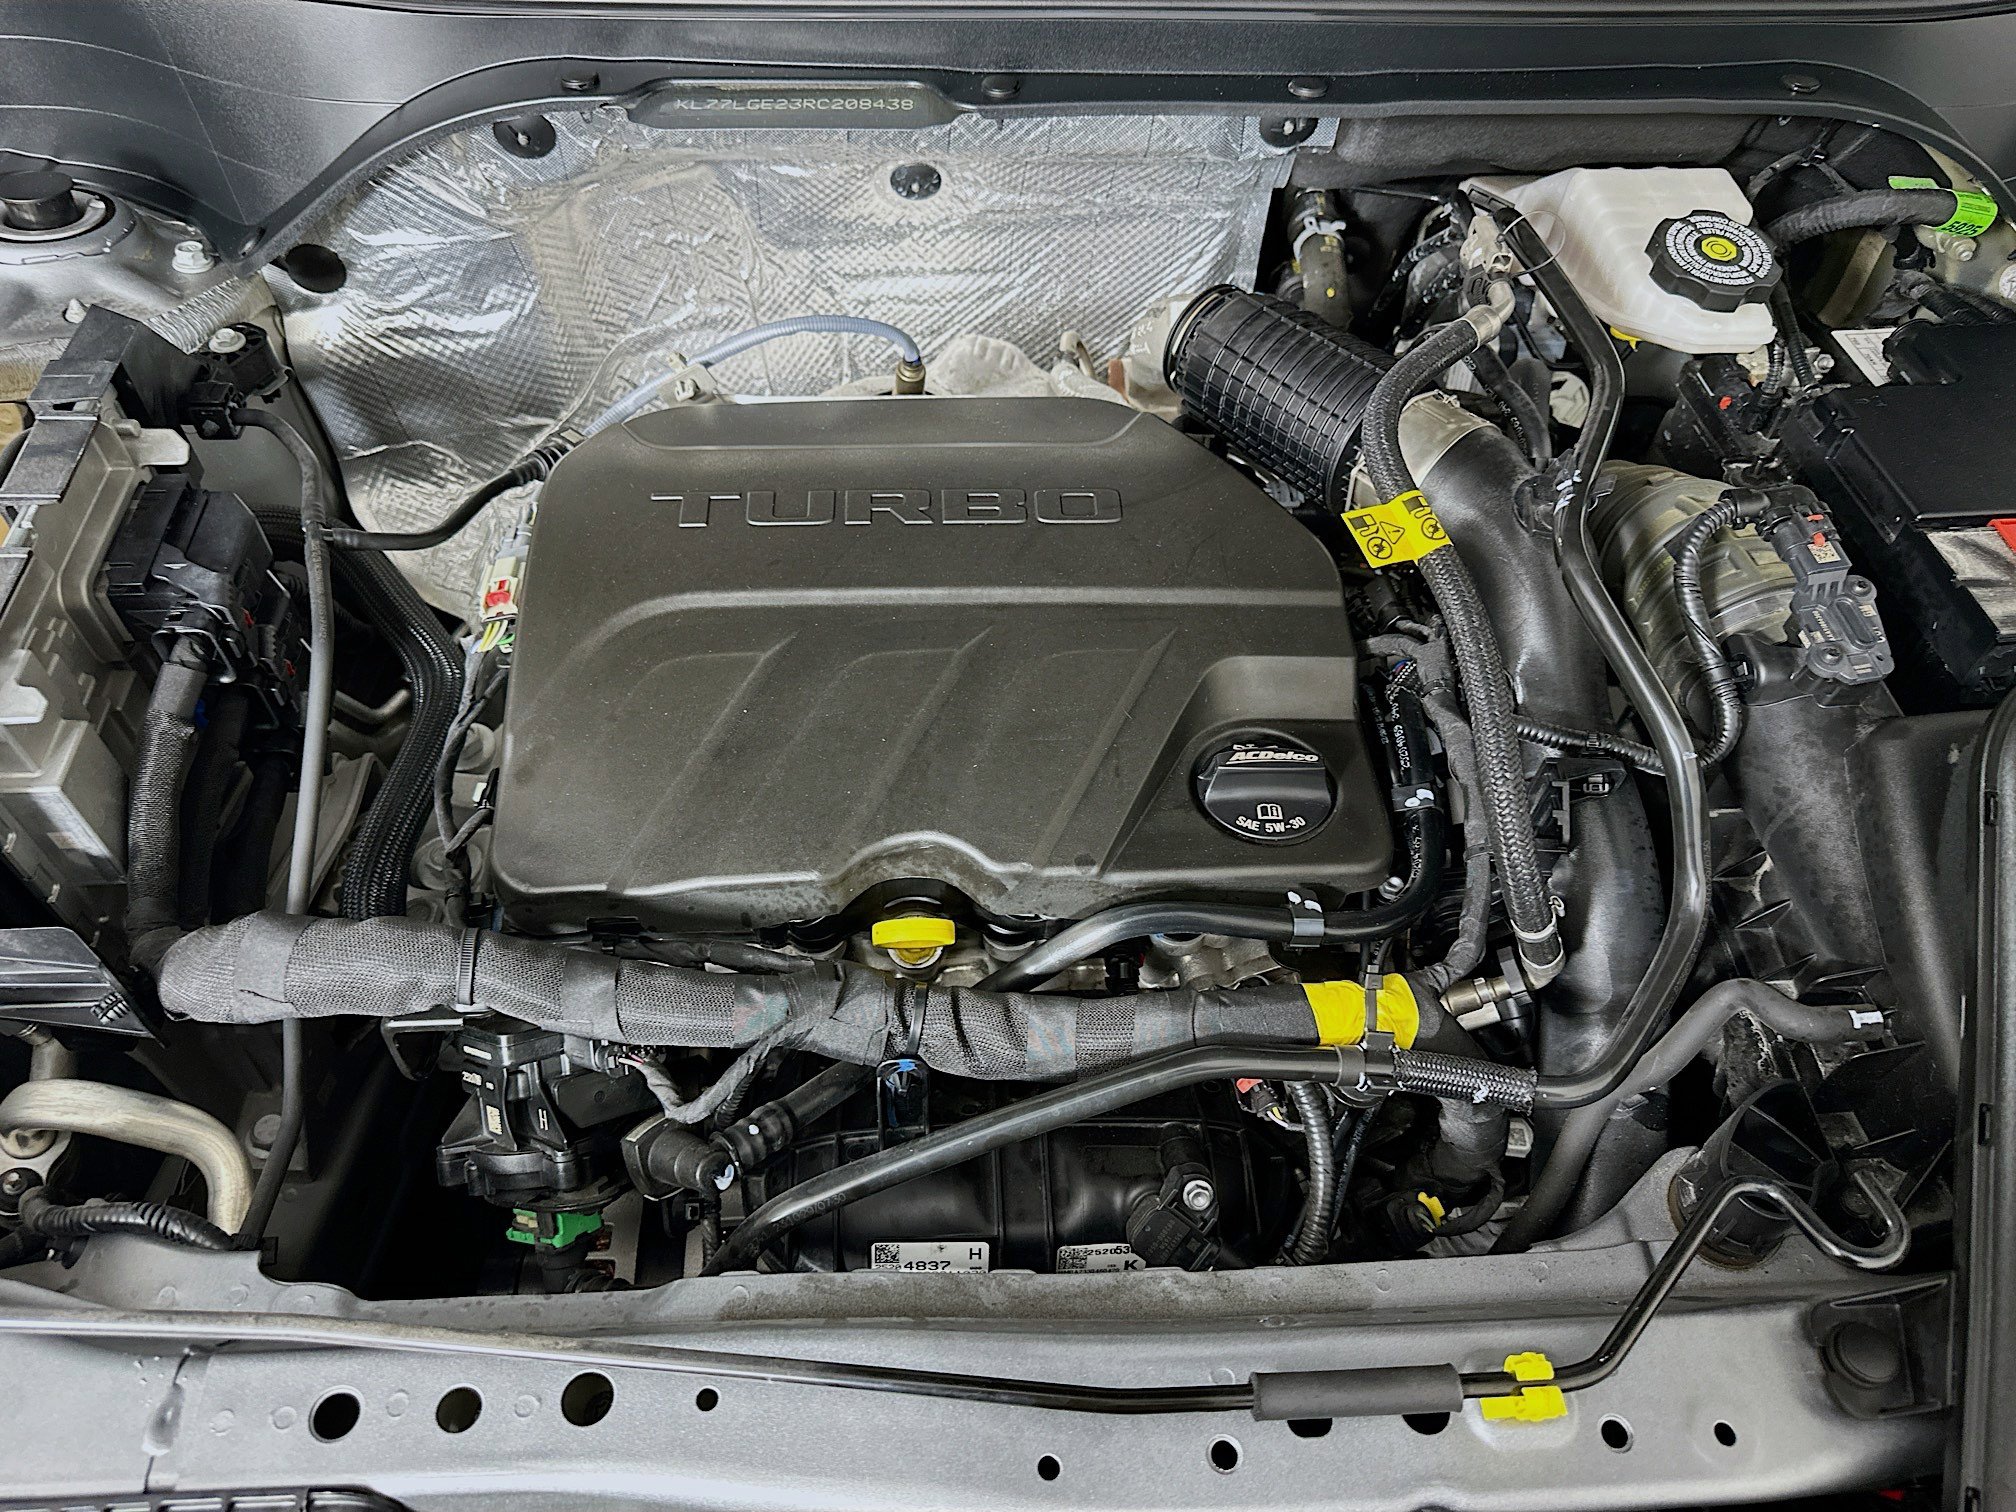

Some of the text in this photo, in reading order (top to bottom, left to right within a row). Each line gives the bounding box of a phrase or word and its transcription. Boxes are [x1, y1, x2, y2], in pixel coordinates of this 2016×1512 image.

[675, 98, 914, 111] KL77LGE23RC208438
[651, 488, 1124, 528] TURBO
[1229, 750, 1319, 763] ACDelco
[1235, 815, 1307, 833] SAE 5W-30
[969, 1247, 982, 1260] H
[1123, 1259, 1139, 1271] K
